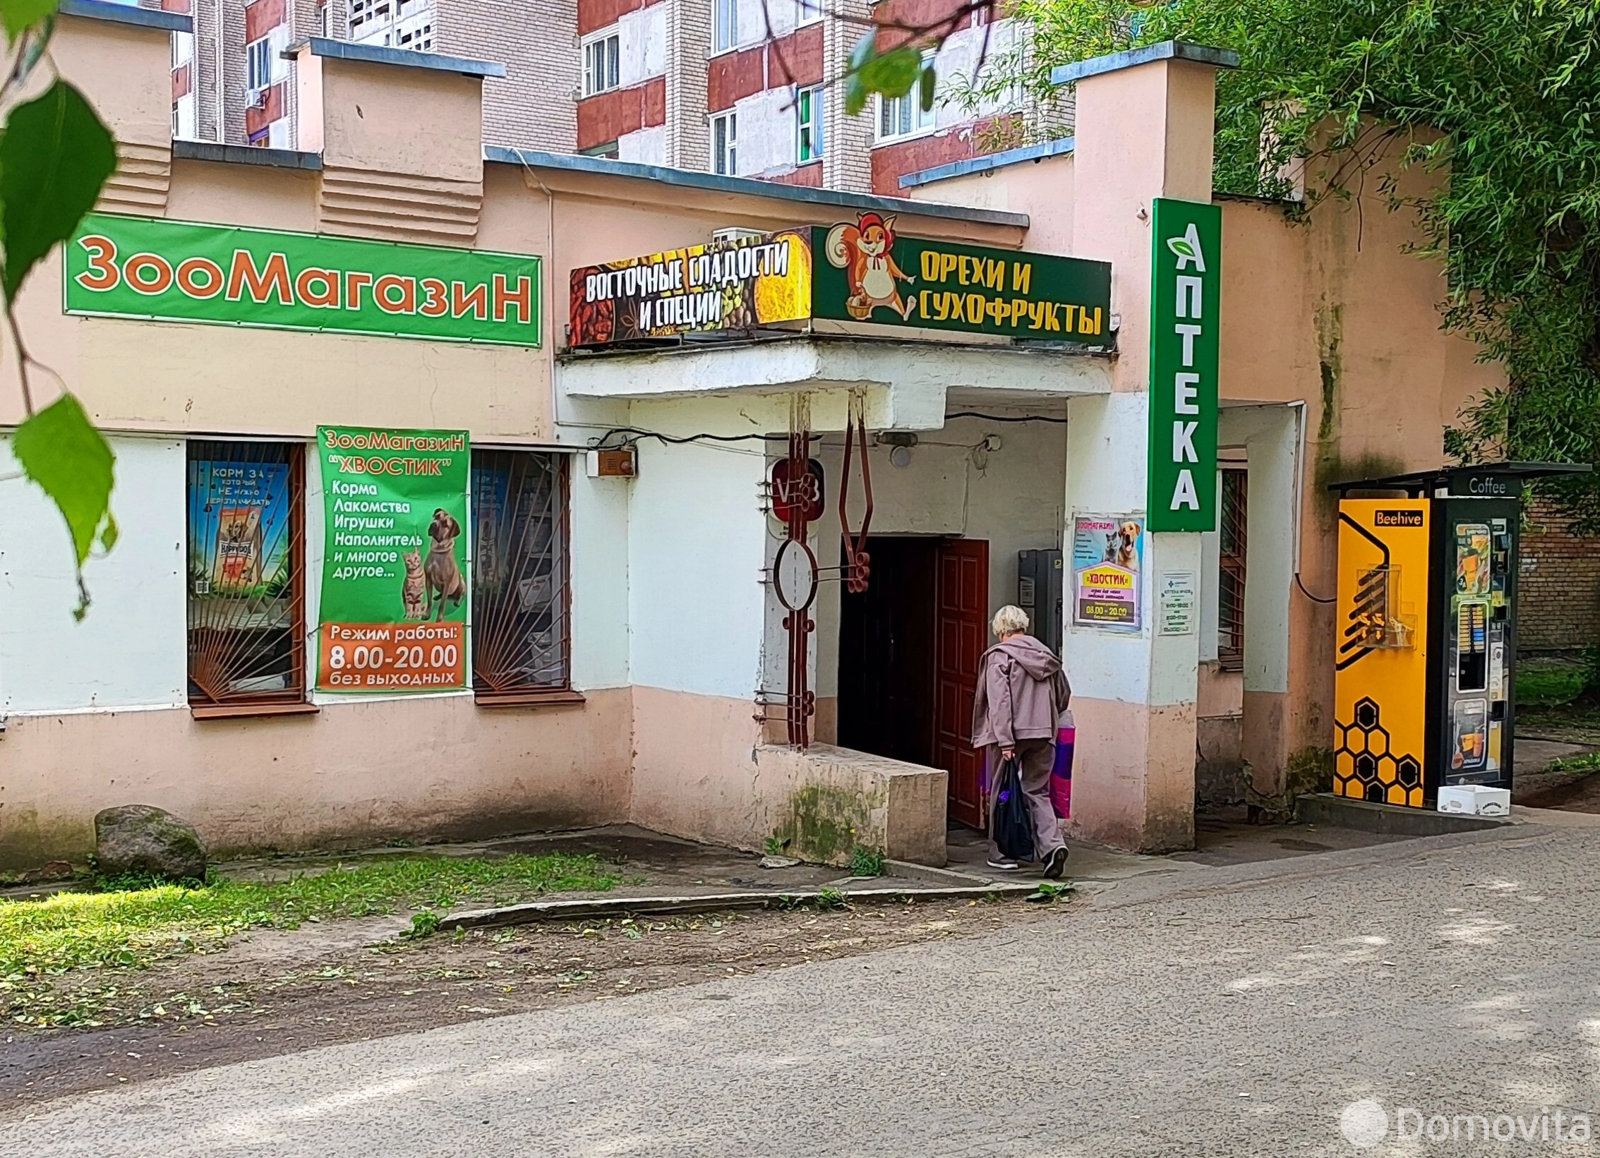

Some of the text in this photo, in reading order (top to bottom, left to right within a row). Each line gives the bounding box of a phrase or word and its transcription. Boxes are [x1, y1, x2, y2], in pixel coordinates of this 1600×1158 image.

[75, 234, 532, 324] ЗооМагазиН
[585, 241, 789, 303] ВОСТОЧНЫЕ СЛАДОСТИ
[920, 250, 1031, 294] ОРЕХИ И
[639, 290, 722, 331] И СПЕЦИИ
[919, 289, 1102, 335] СУХОФРУКТЫ
[1168, 222, 1207, 512] АПТЕКА
[325, 429, 465, 452] ЗооМагазиН
[212, 467, 244, 478] КОРМ
[332, 480, 377, 497] Корма
[1469, 477, 1506, 494] Coffee
[333, 498, 410, 513] Лакомства
[334, 514, 394, 531] Игрушки
[1376, 511, 1421, 525] Beehive
[334, 532, 423, 546] Наполнитель
[333, 551, 397, 563] и многое
[332, 566, 395, 580] другое...
[330, 625, 458, 643] Режим работы:
[329, 644, 458, 669] 8.00-20.00
[329, 671, 455, 686] без выходных
